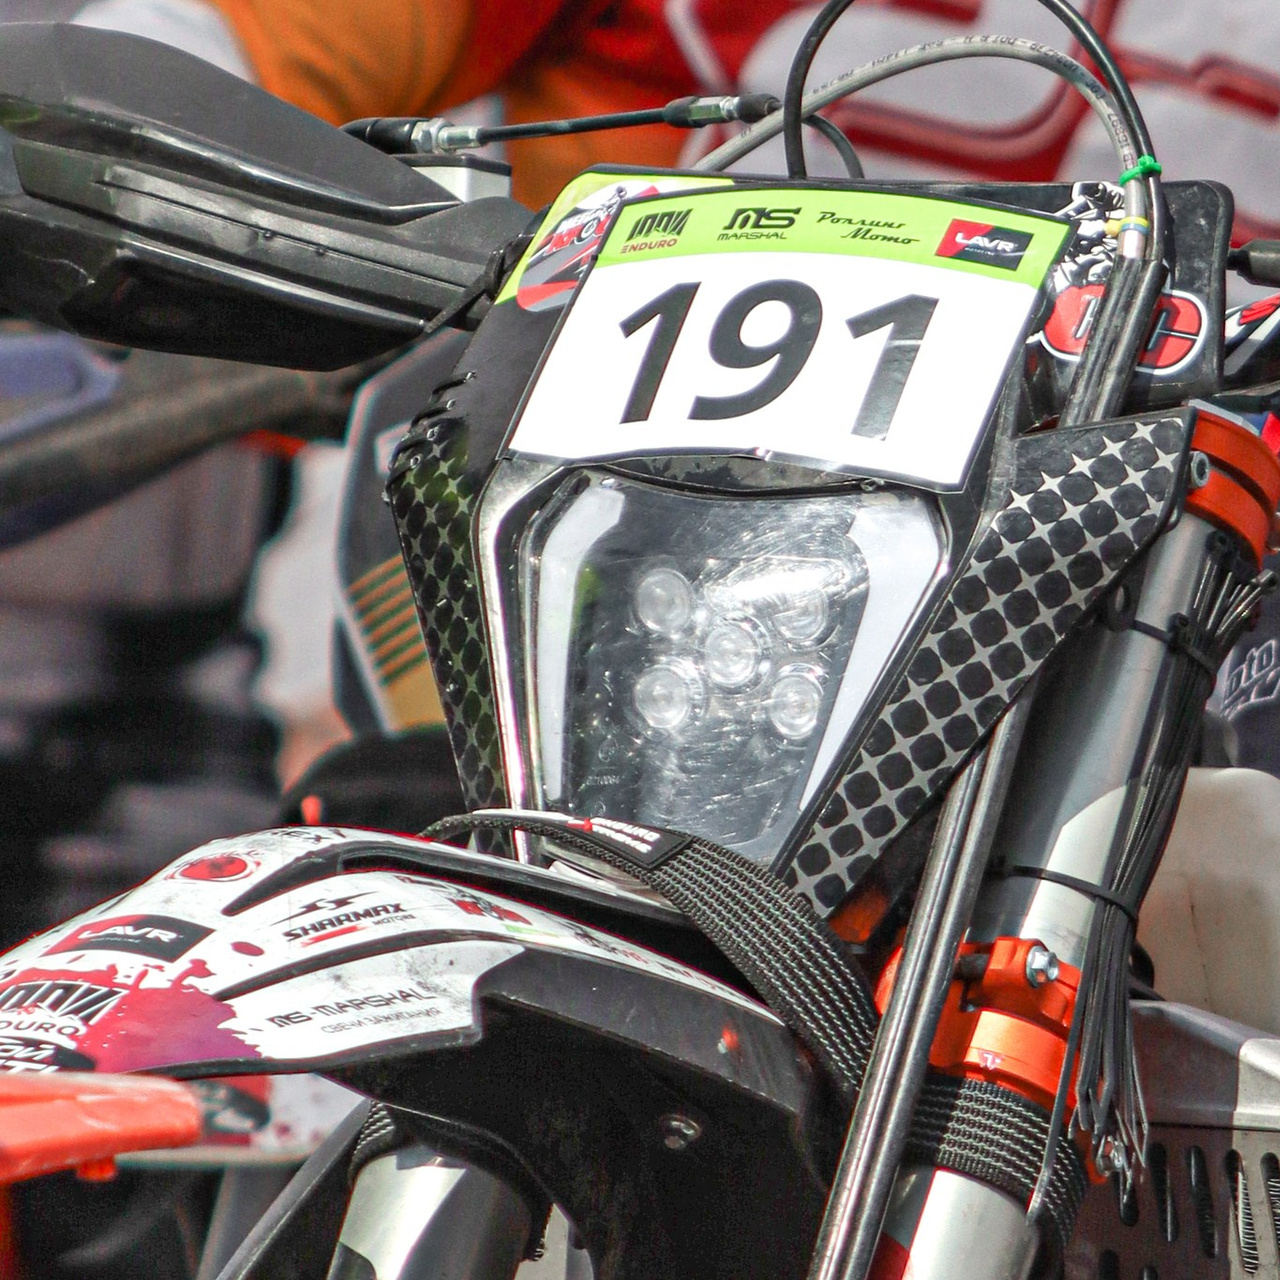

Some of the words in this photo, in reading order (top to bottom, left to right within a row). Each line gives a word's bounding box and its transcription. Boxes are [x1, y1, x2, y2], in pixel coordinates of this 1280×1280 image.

[619, 238, 679, 255] ENDURO
[716, 231, 788, 242] MARSHAL
[955, 232, 1015, 253] LAVR
[618, 278, 940, 441] 191
[282, 902, 408, 943] SHARMAX
[77, 924, 180, 944] LAVR
